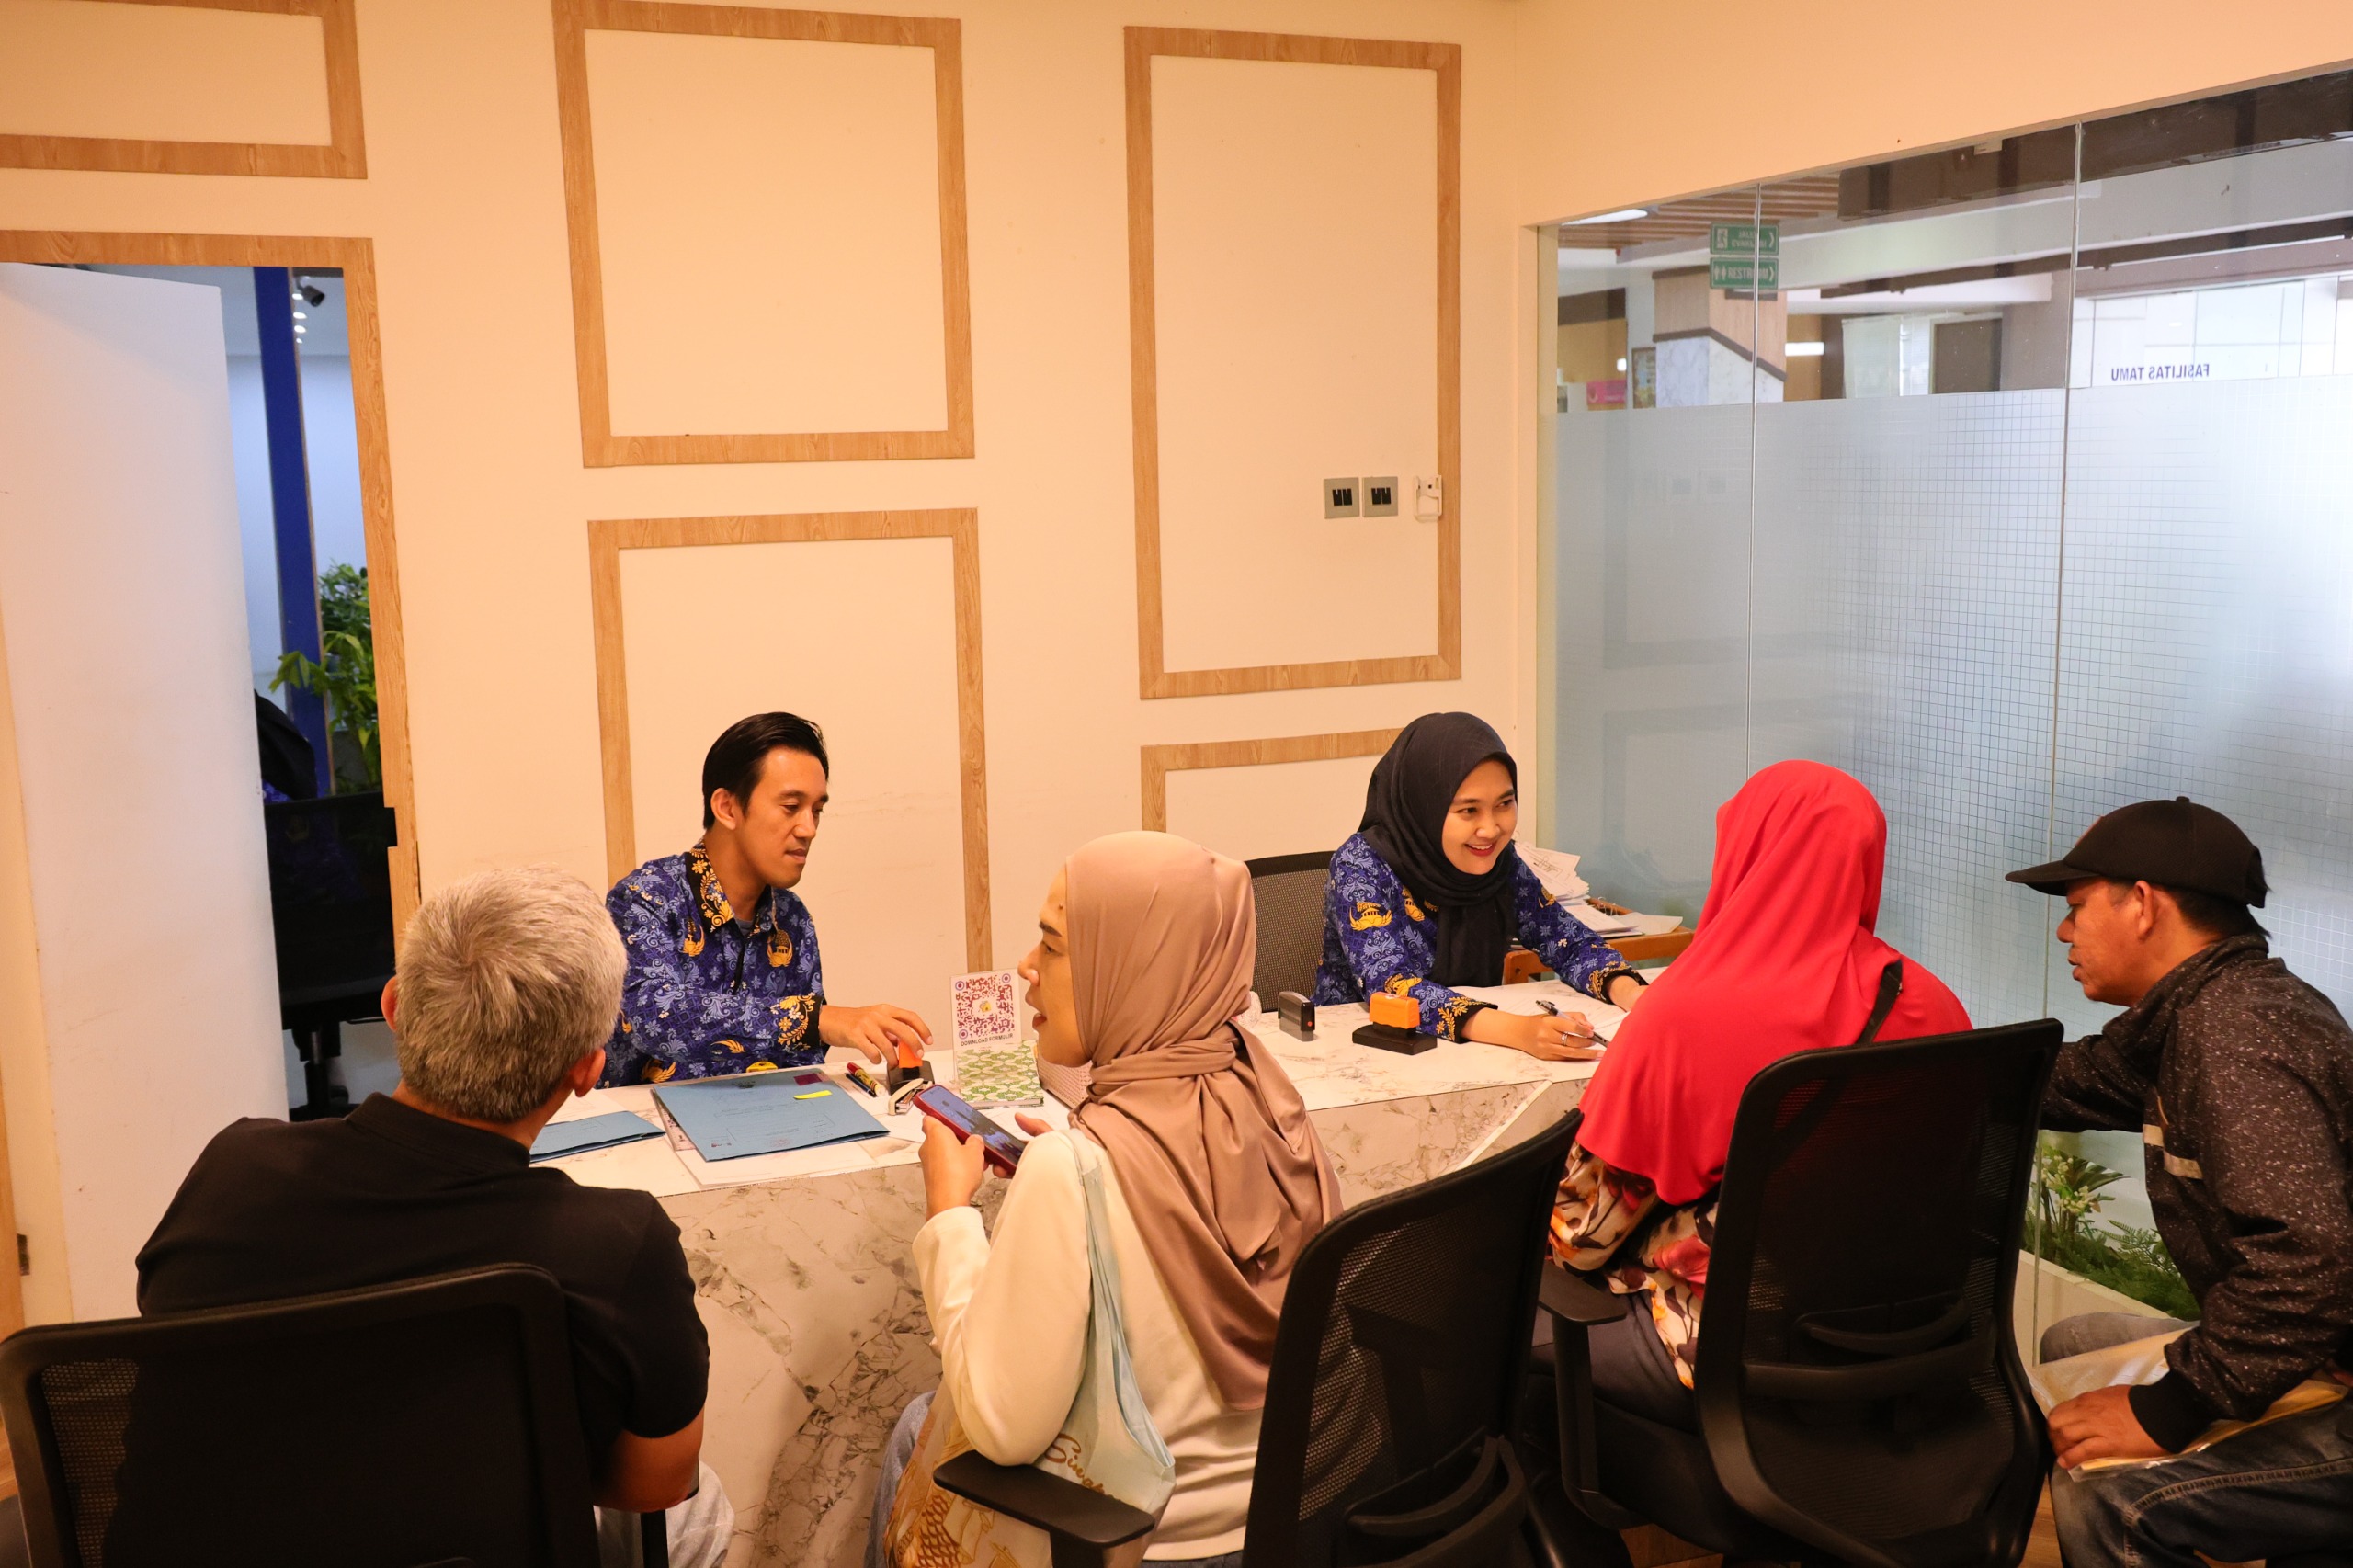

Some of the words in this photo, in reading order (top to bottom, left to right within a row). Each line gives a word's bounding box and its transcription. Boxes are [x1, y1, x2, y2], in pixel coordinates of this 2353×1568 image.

[1728, 267, 1768, 279] RESTROM
[961, 1037, 989, 1047] DOWNLOAD
[989, 1032, 1014, 1041] FORMULIR
